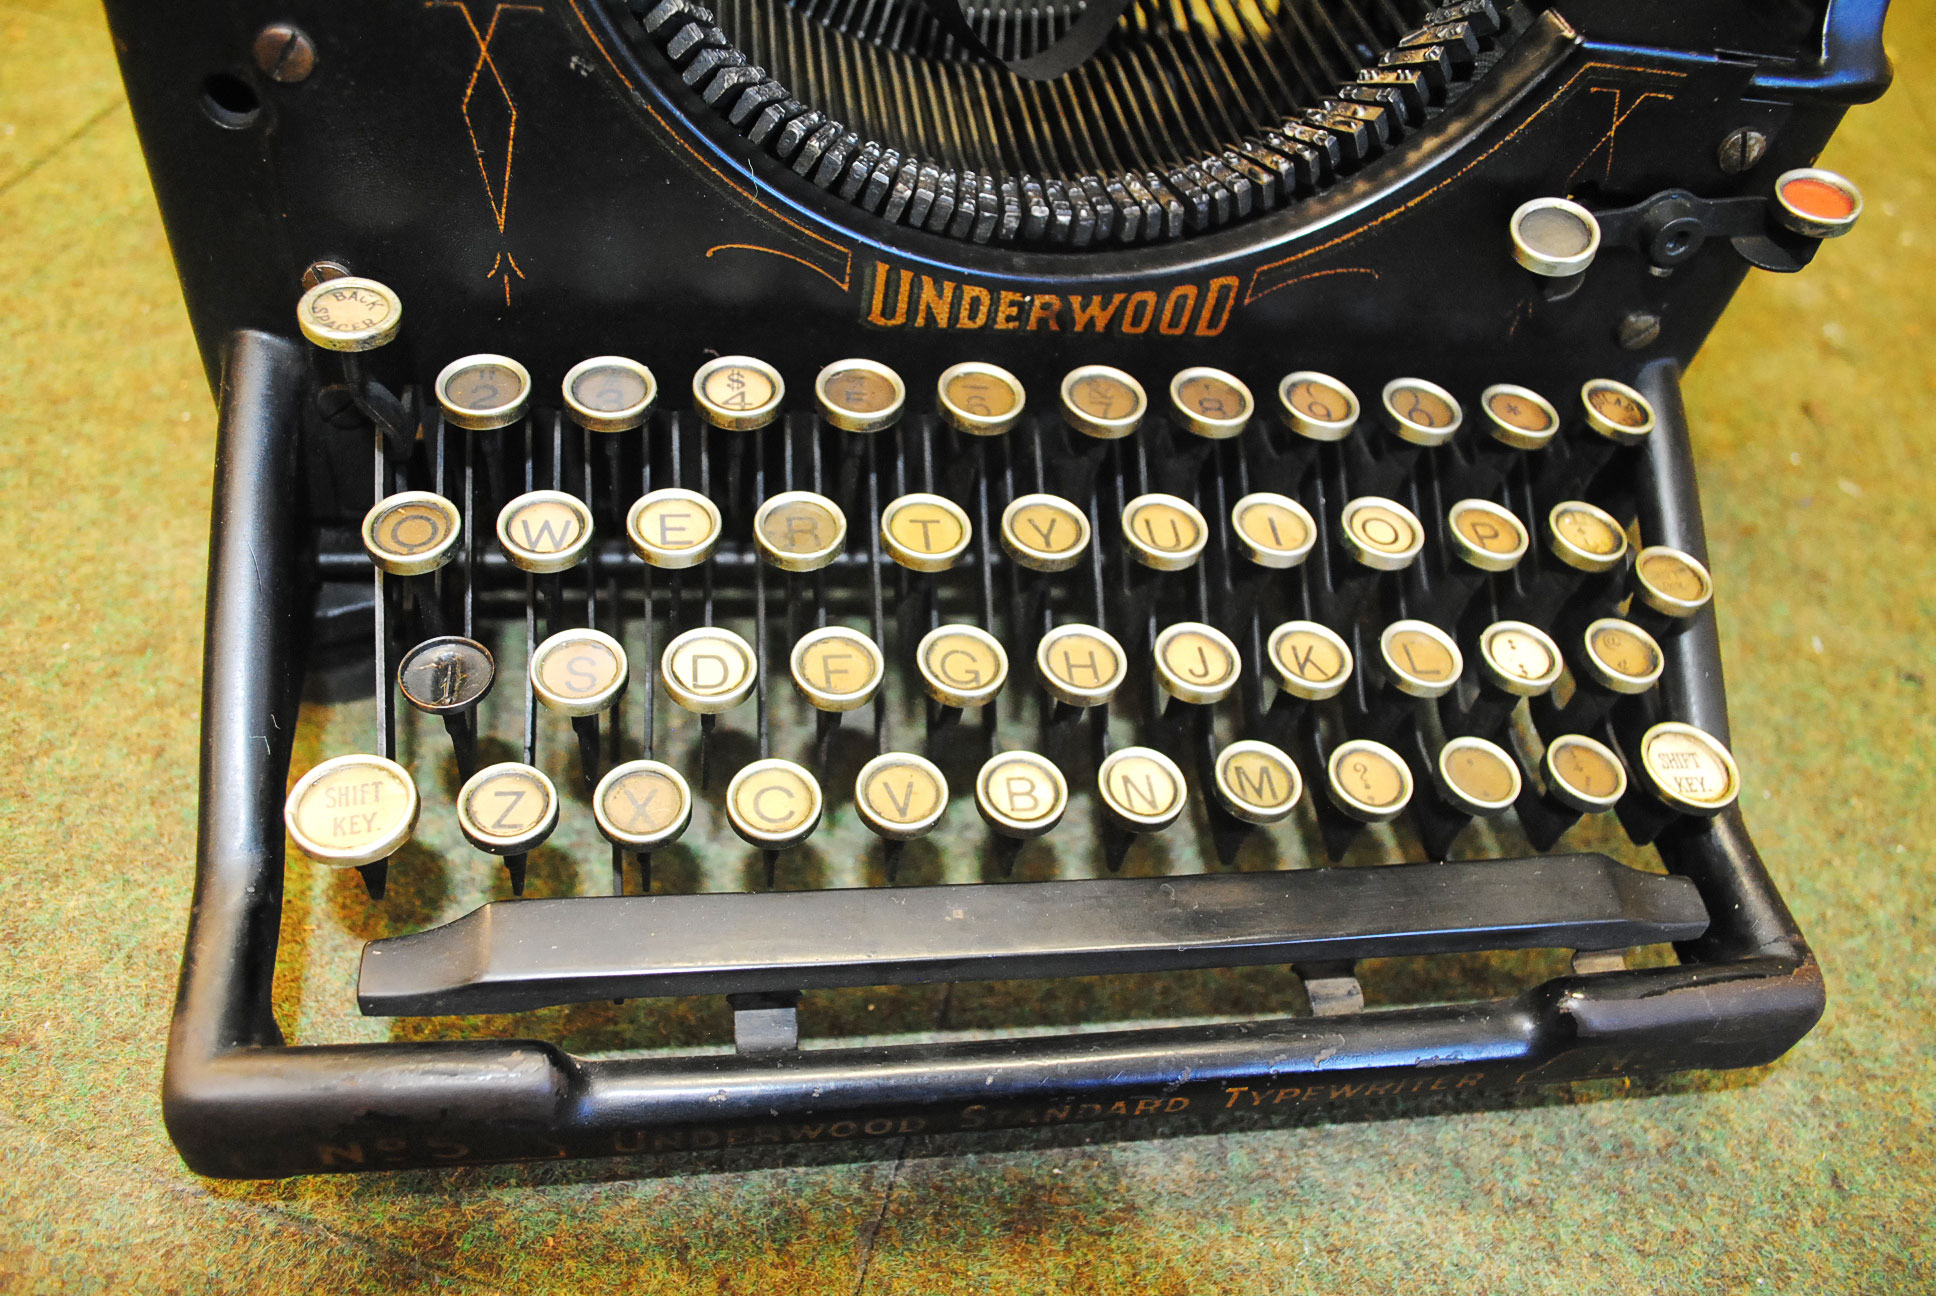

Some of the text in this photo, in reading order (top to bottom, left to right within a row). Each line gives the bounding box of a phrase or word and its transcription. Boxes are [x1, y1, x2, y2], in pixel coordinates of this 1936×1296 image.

[332, 290, 385, 311] BACK
[866, 260, 1240, 337] UNDERWOOD
[311, 307, 376, 331] SPACER
[726, 369, 745, 391] $
[470, 386, 498, 410] 2
[721, 391, 753, 409] 4
[521, 520, 569, 552] W
[659, 513, 692, 546] E
[787, 516, 818, 549] R
[909, 519, 941, 551] T
[1028, 517, 1056, 549] Y
[1144, 518, 1182, 550] U
[1268, 516, 1282, 547] I
[1363, 515, 1399, 546] O
[1470, 521, 1499, 547] P
[565, 656, 597, 692] S
[691, 654, 729, 690] D
[822, 653, 853, 689] F
[940, 650, 981, 687] G
[1063, 649, 1097, 686] H
[1187, 645, 1209, 679] J
[1291, 644, 1330, 679] K
[1402, 642, 1441, 676] L
[1352, 762, 1371, 789] ?
[1657, 751, 1702, 771] SHIFT
[324, 780, 385, 809] SHIFT
[1004, 776, 1037, 812] B
[1121, 774, 1158, 811] N
[1233, 765, 1279, 801] M
[492, 790, 527, 830] Z
[622, 787, 660, 829] X
[752, 785, 796, 823] C
[881, 781, 915, 819] V
[613, 1115, 927, 1153] UNDERWOOD
[1223, 1071, 1487, 1110] TYPEWRITER
